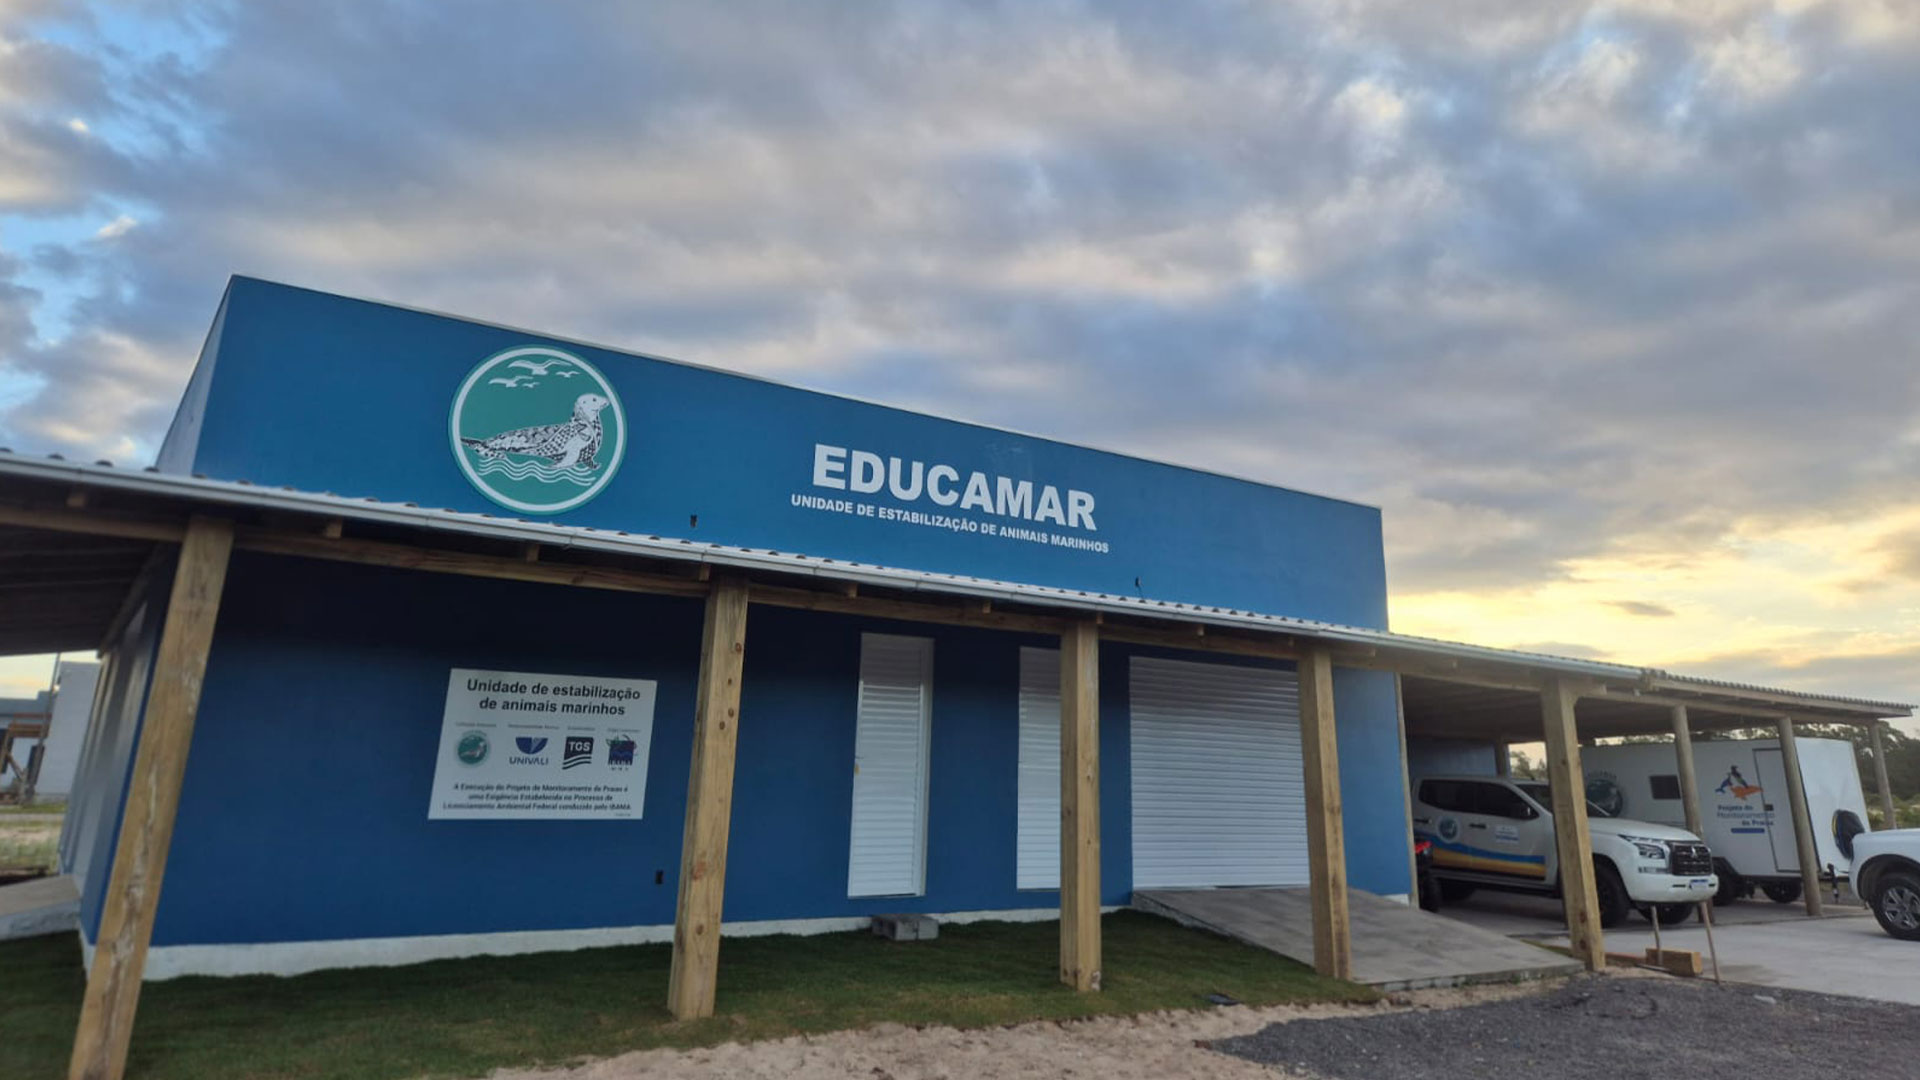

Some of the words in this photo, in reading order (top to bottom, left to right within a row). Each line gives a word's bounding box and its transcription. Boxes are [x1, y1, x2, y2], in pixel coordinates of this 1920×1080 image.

[813, 443, 1097, 531] EDUCAMAR
[791, 494, 853, 514] UNIDADE
[857, 503, 875, 517] DE
[878, 505, 978, 533] ESTABILIZAÇÃO
[980, 521, 997, 536] DE
[999, 526, 1048, 544] ANIMAIS
[1051, 533, 1110, 553] MARINHOS
[467, 679, 527, 695] Unidade
[531, 682, 548, 696] de
[552, 685, 641, 700] estabilização
[479, 697, 497, 710] de
[501, 698, 557, 712] animais
[561, 702, 625, 716] marinhos
[509, 756, 549, 766] UNIVALI
